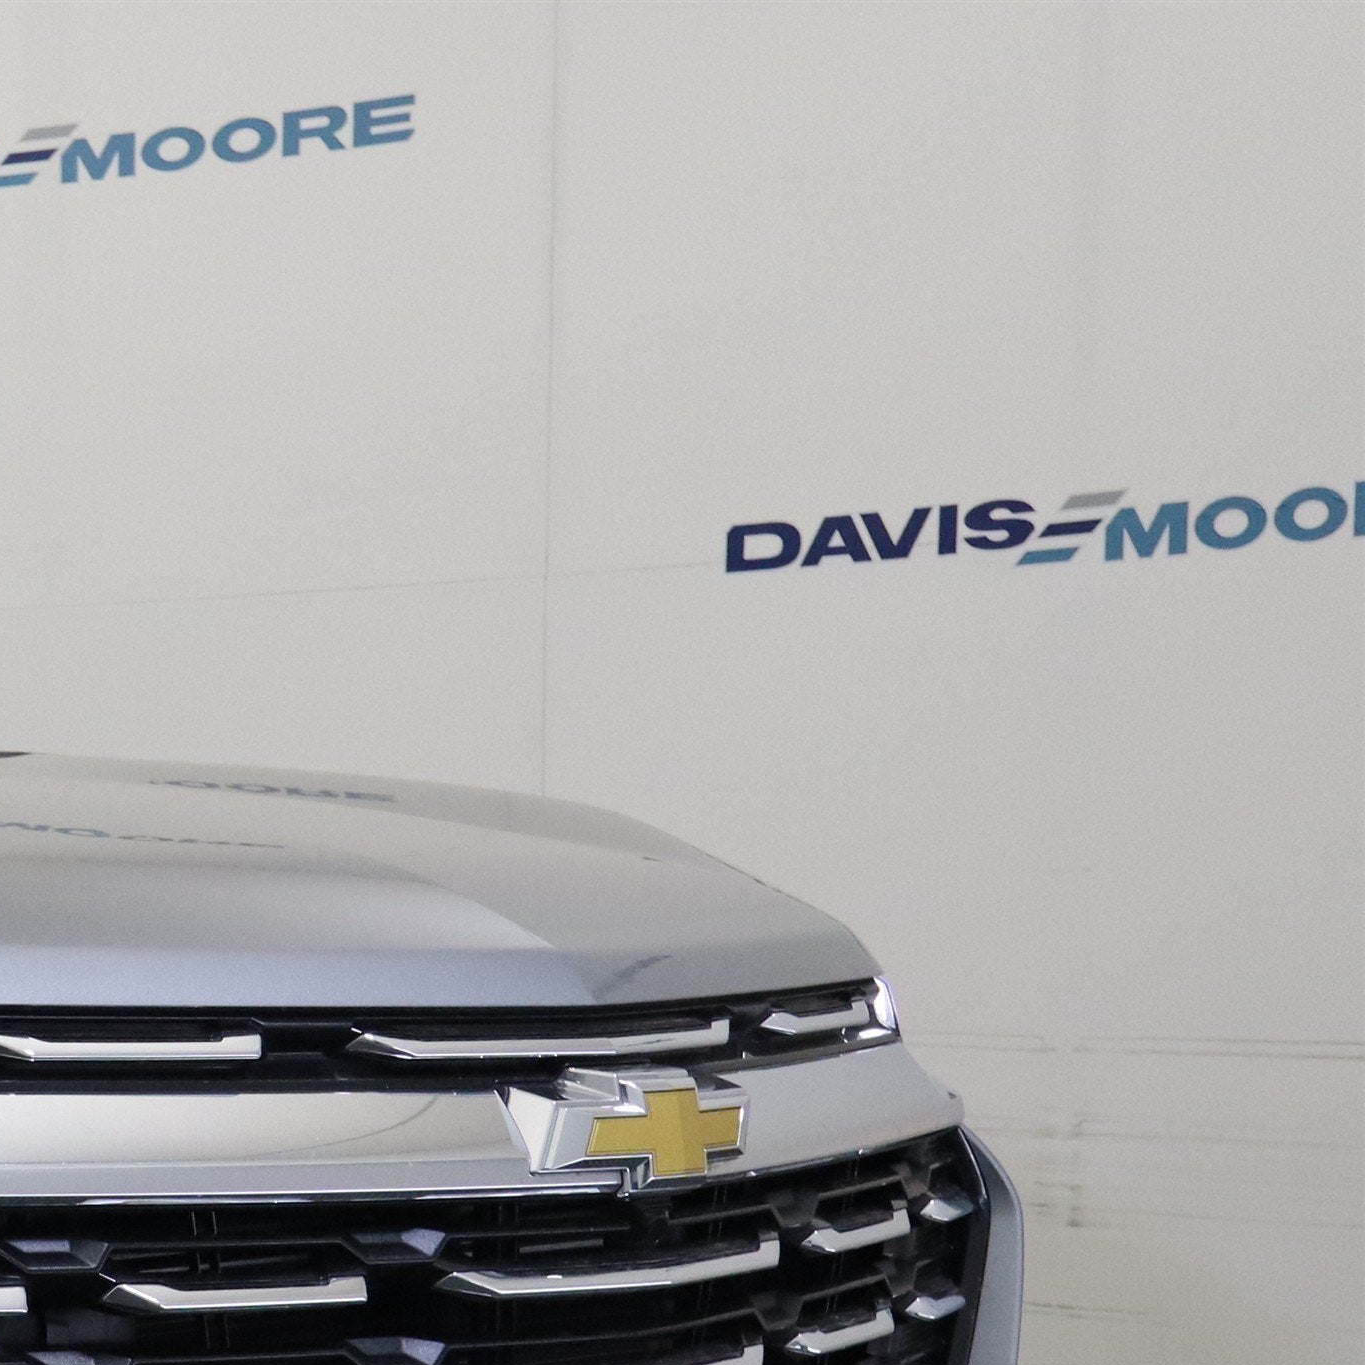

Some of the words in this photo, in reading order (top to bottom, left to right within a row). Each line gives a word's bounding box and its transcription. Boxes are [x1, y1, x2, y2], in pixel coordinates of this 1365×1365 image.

[60, 94, 416, 184] MOORE
[724, 498, 1036, 574] DAVIS
[1104, 480, 1365, 562] MOO
